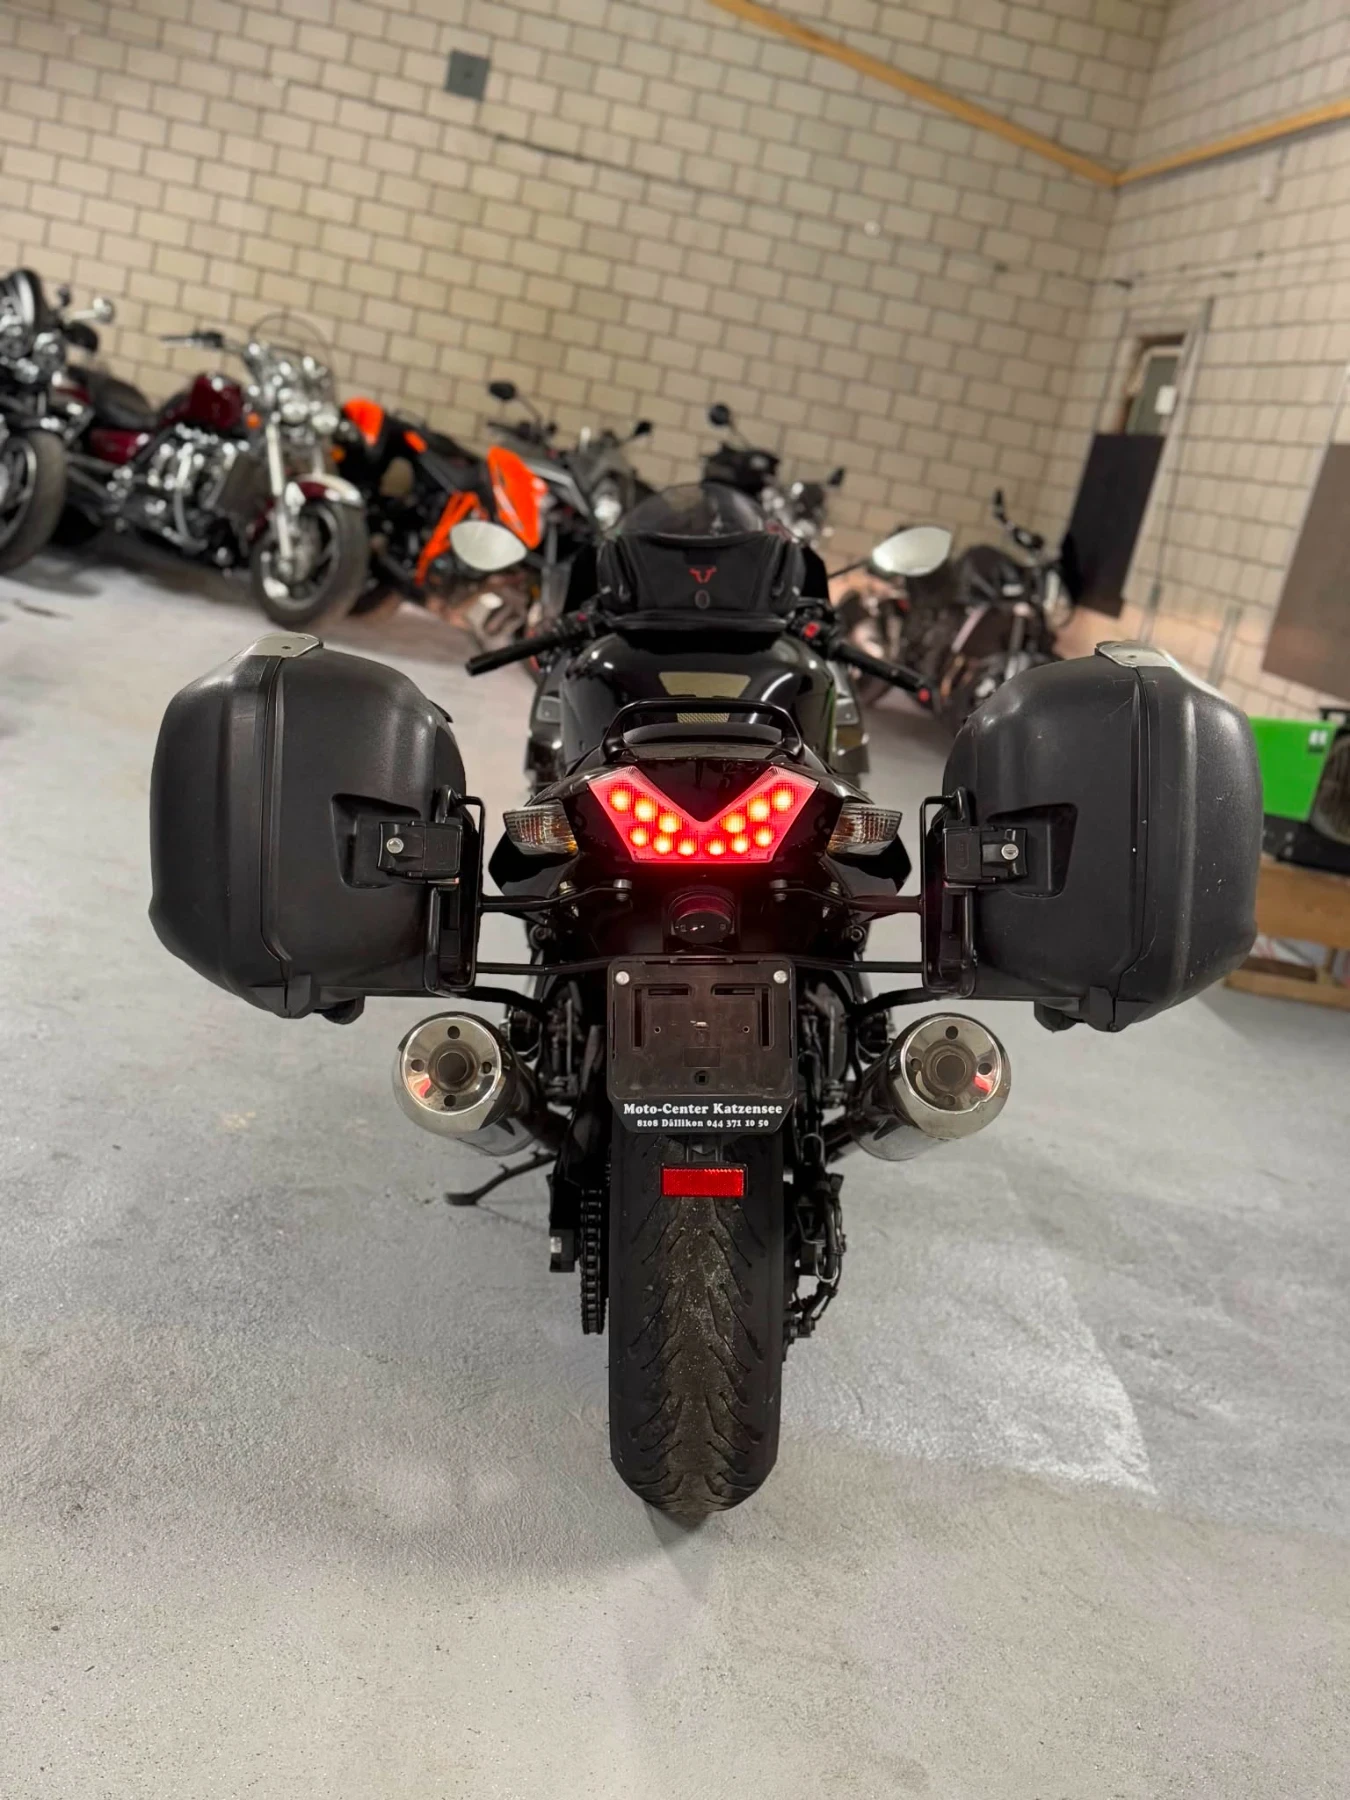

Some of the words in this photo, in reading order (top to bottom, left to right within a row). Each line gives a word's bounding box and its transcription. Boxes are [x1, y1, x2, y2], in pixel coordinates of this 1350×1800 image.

[623, 1103, 709, 1115] Moto-Center
[713, 1103, 783, 1115] Katzensee
[637, 1119, 659, 1127] 8108
[706, 1119, 724, 1128] 044
[726, 1119, 742, 1128] 371
[744, 1119, 756, 1127] 10
[757, 1119, 769, 1128] 50
